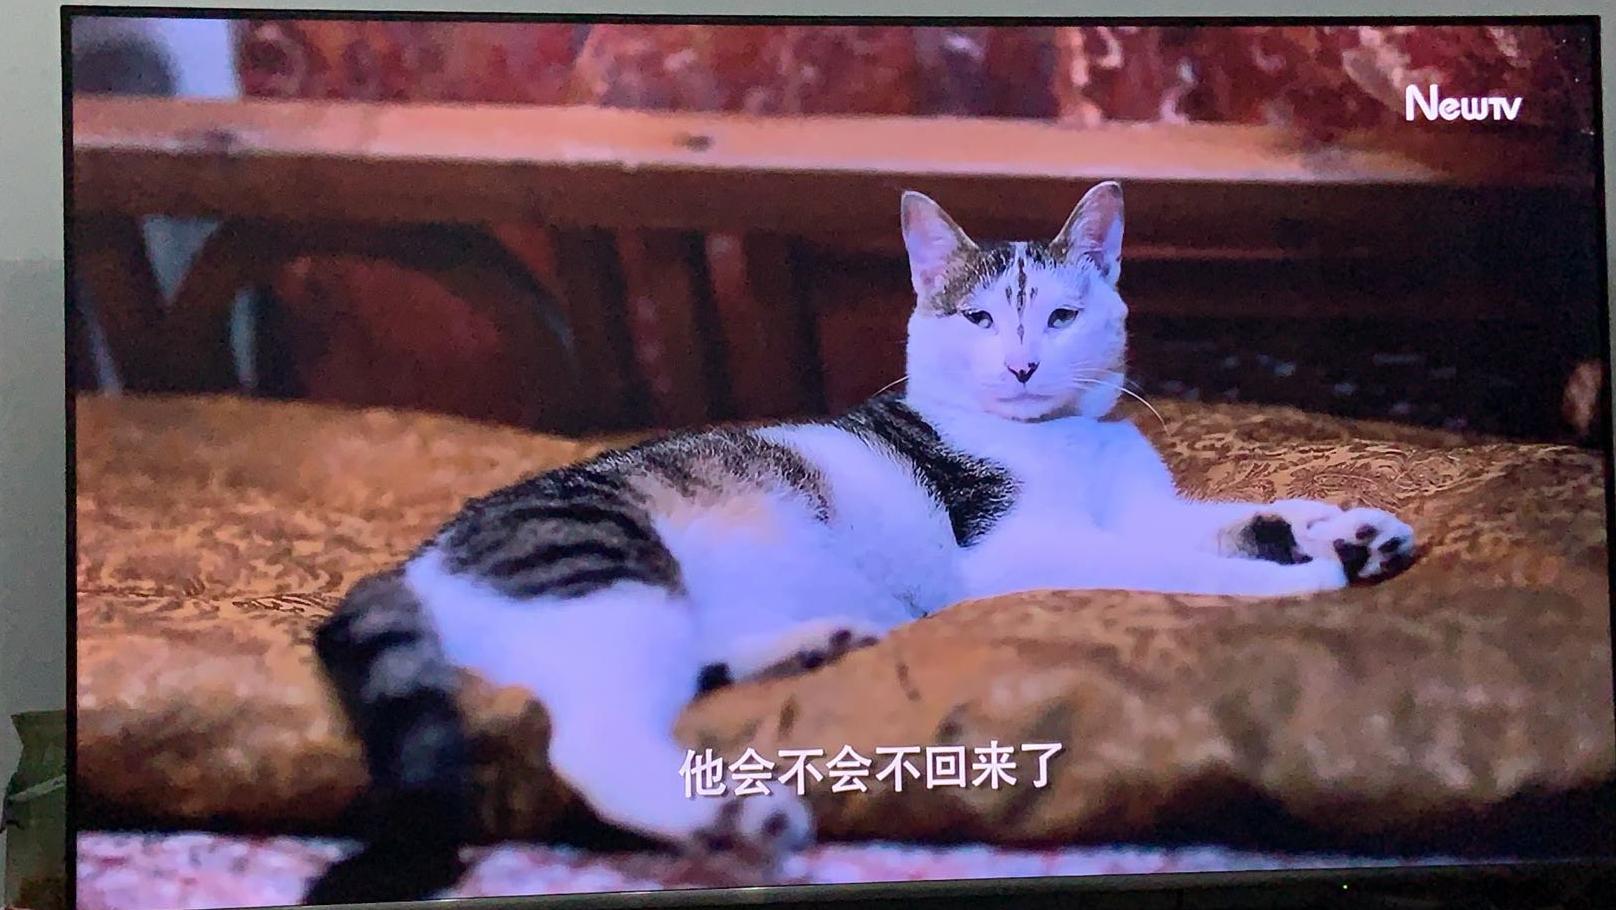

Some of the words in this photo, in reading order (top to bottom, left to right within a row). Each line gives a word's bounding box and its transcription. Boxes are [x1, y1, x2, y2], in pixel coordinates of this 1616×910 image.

[678, 740, 1063, 798] 他会不会不回来了
